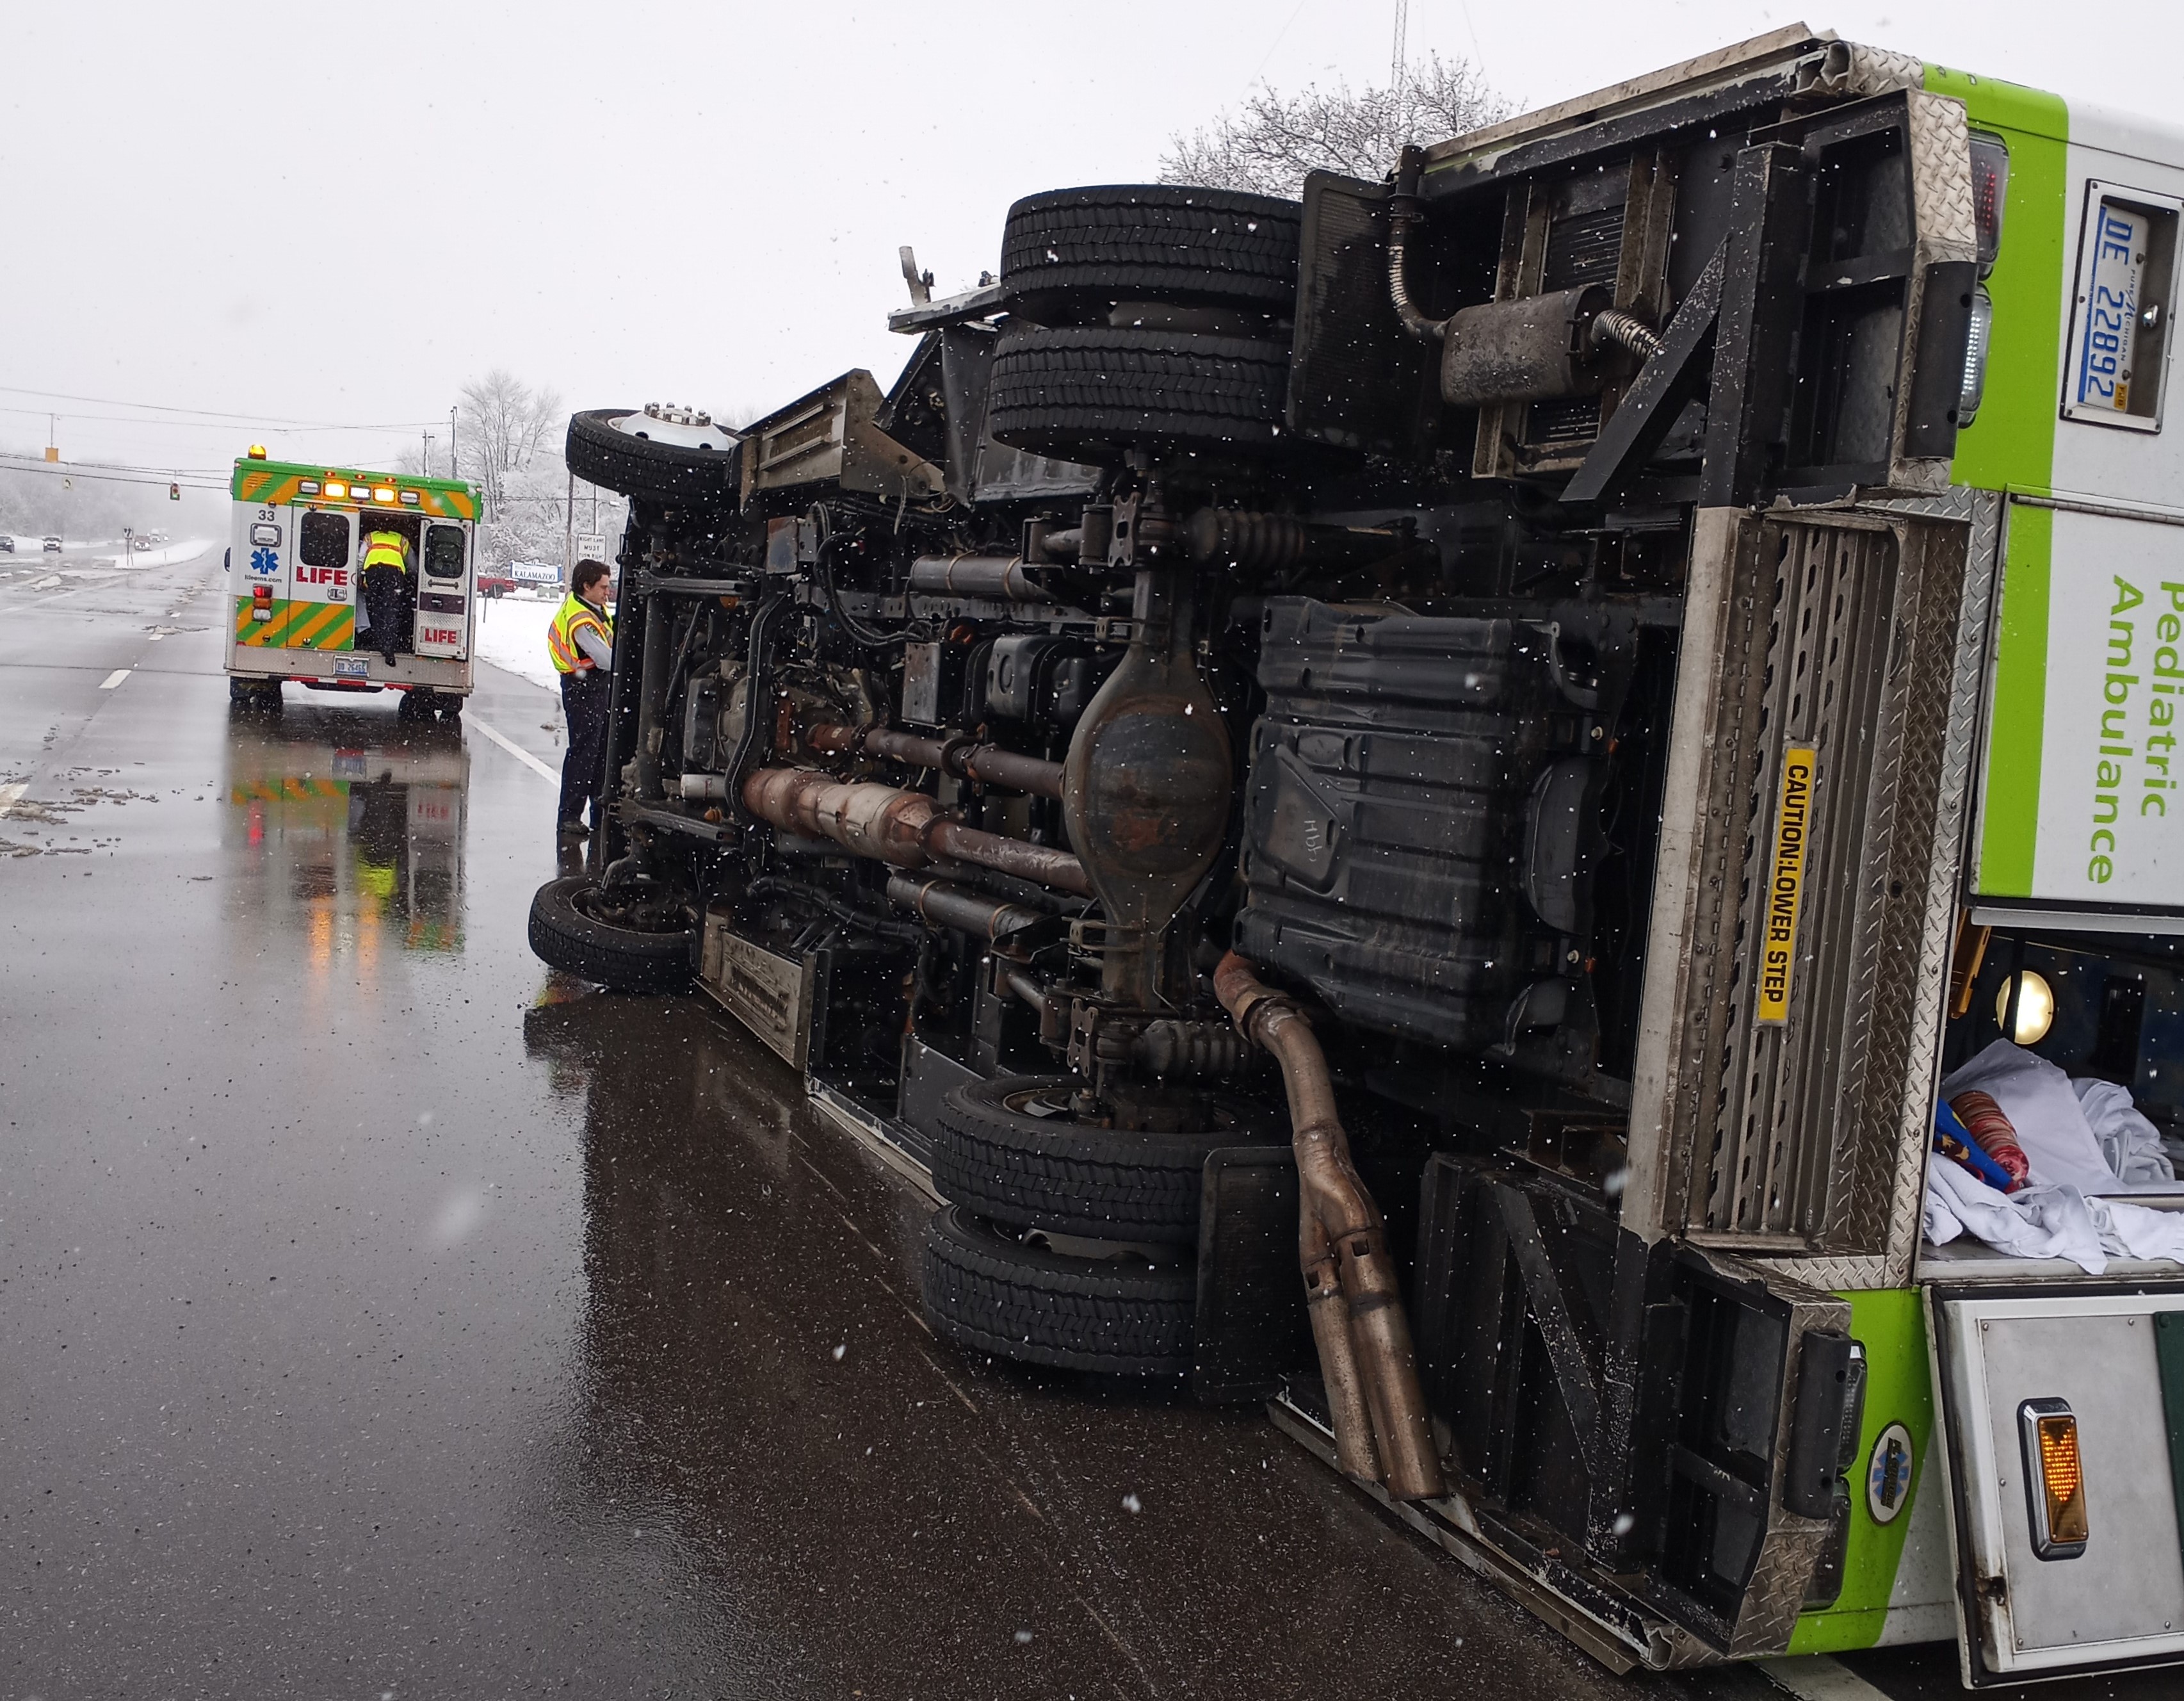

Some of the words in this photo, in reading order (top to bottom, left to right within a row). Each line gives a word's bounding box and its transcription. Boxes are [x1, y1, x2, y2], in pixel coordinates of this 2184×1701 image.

[2102, 217, 2133, 265] DE
[2087, 286, 2124, 398] 22892
[258, 510, 275, 521] 33
[296, 566, 348, 586] LIFE
[514, 571, 555, 581] KALAMAZOO
[425, 628, 457, 644] LIFE
[2141, 582, 2184, 817] Pediatric
[2088, 574, 2144, 884] Ambulance
[1764, 950, 1788, 1003] STEP
